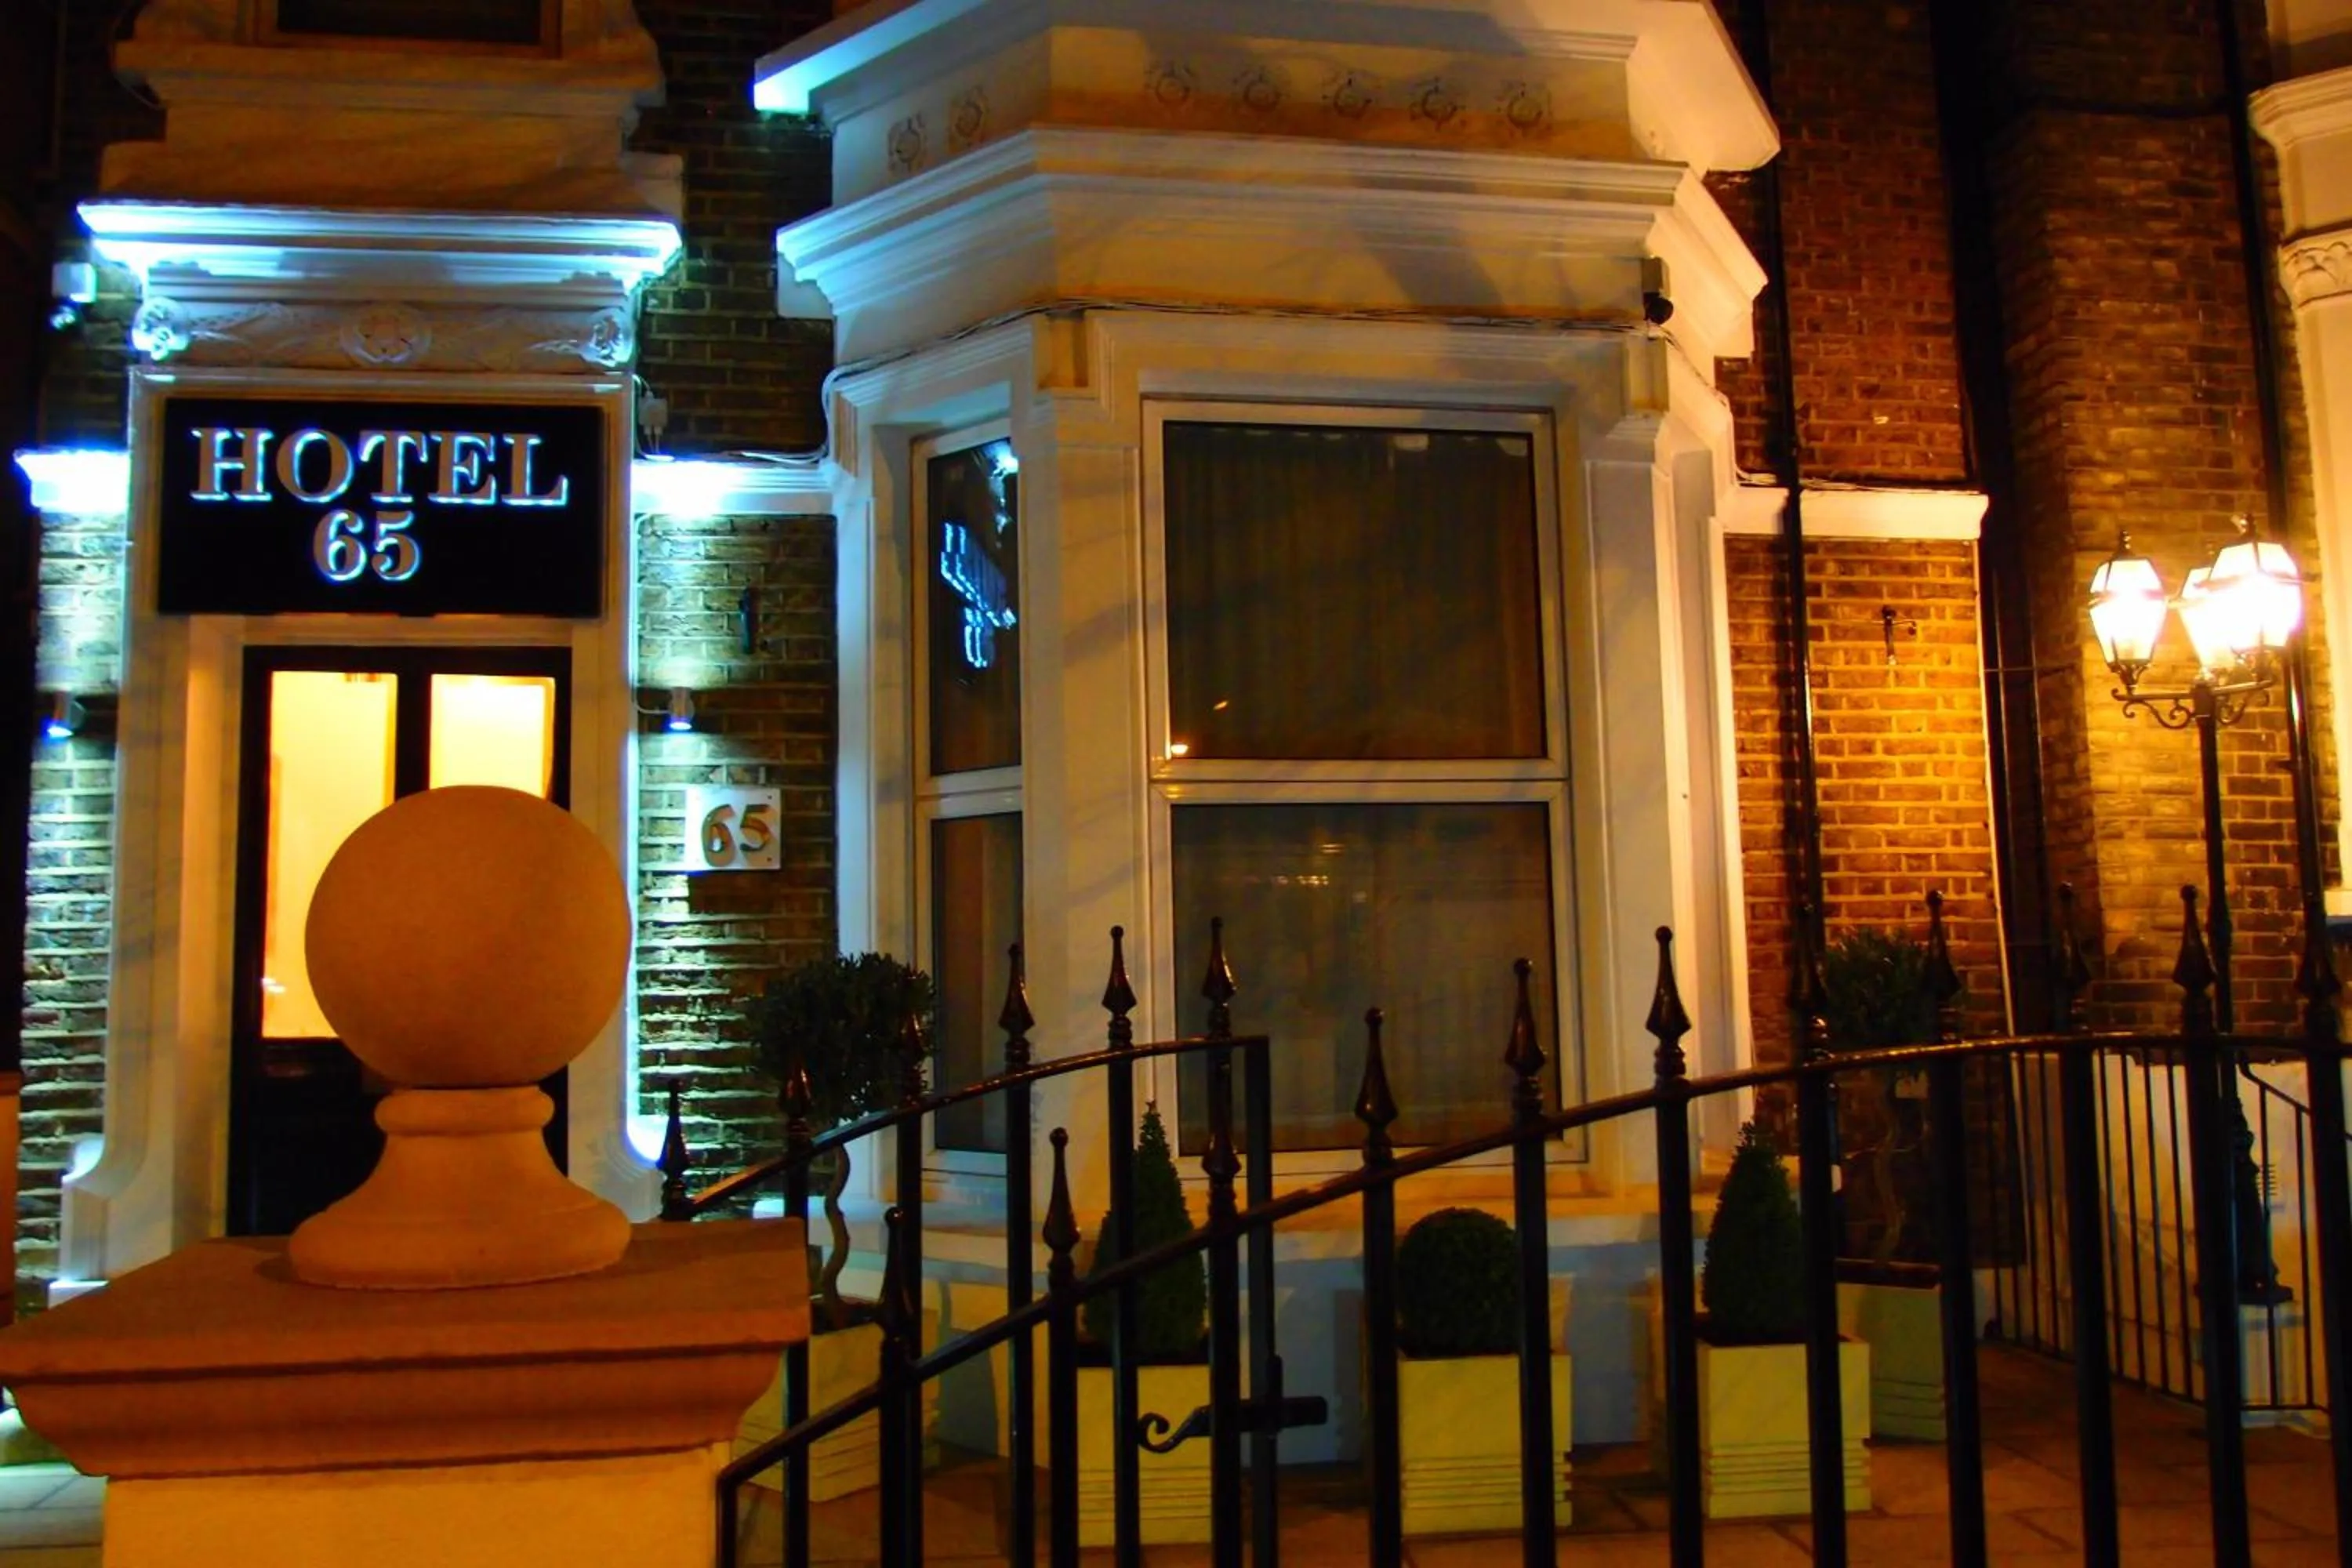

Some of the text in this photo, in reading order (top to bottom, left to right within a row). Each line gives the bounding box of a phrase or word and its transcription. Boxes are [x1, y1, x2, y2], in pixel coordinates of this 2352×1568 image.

[191, 426, 569, 506] HOTEL
[313, 509, 421, 582] 65
[701, 804, 774, 866] 65
